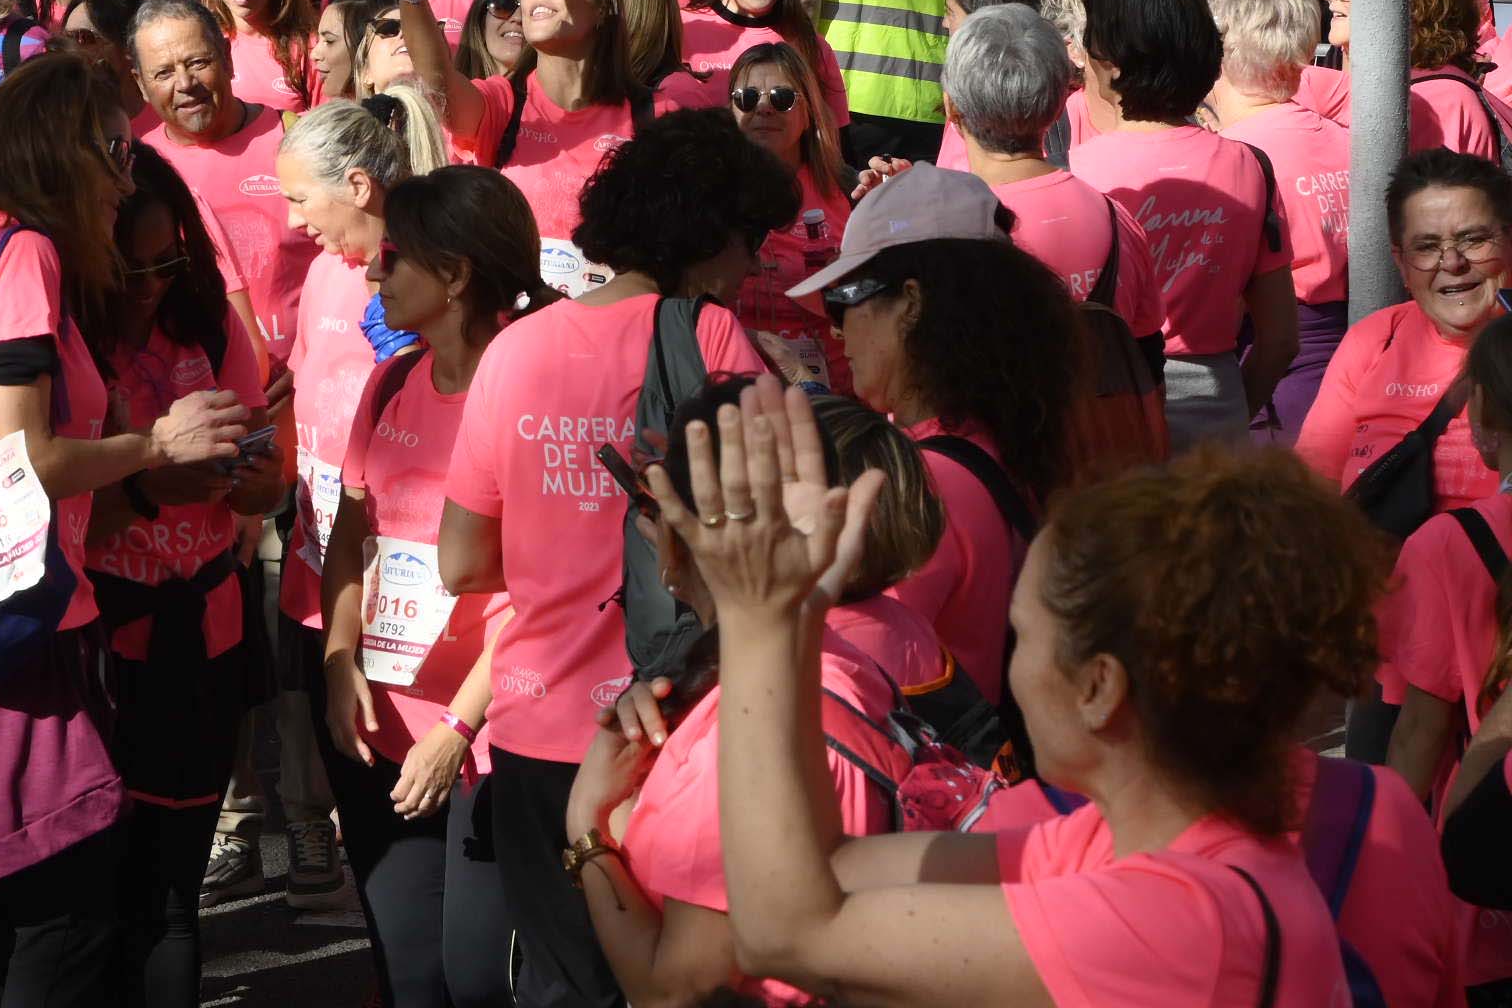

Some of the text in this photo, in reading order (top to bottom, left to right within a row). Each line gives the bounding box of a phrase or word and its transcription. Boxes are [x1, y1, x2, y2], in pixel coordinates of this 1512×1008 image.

[1316, 194, 1338, 214] DE
[1385, 382, 1438, 398] OYSHO
[516, 415, 636, 442] CARRERA
[544, 443, 607, 469] DE L
[578, 501, 600, 513] 2023
[315, 507, 334, 529] 01
[378, 595, 418, 619] 016
[379, 622, 406, 636] 9792
[377, 639, 386, 648] DE
[387, 641, 397, 650] LA
